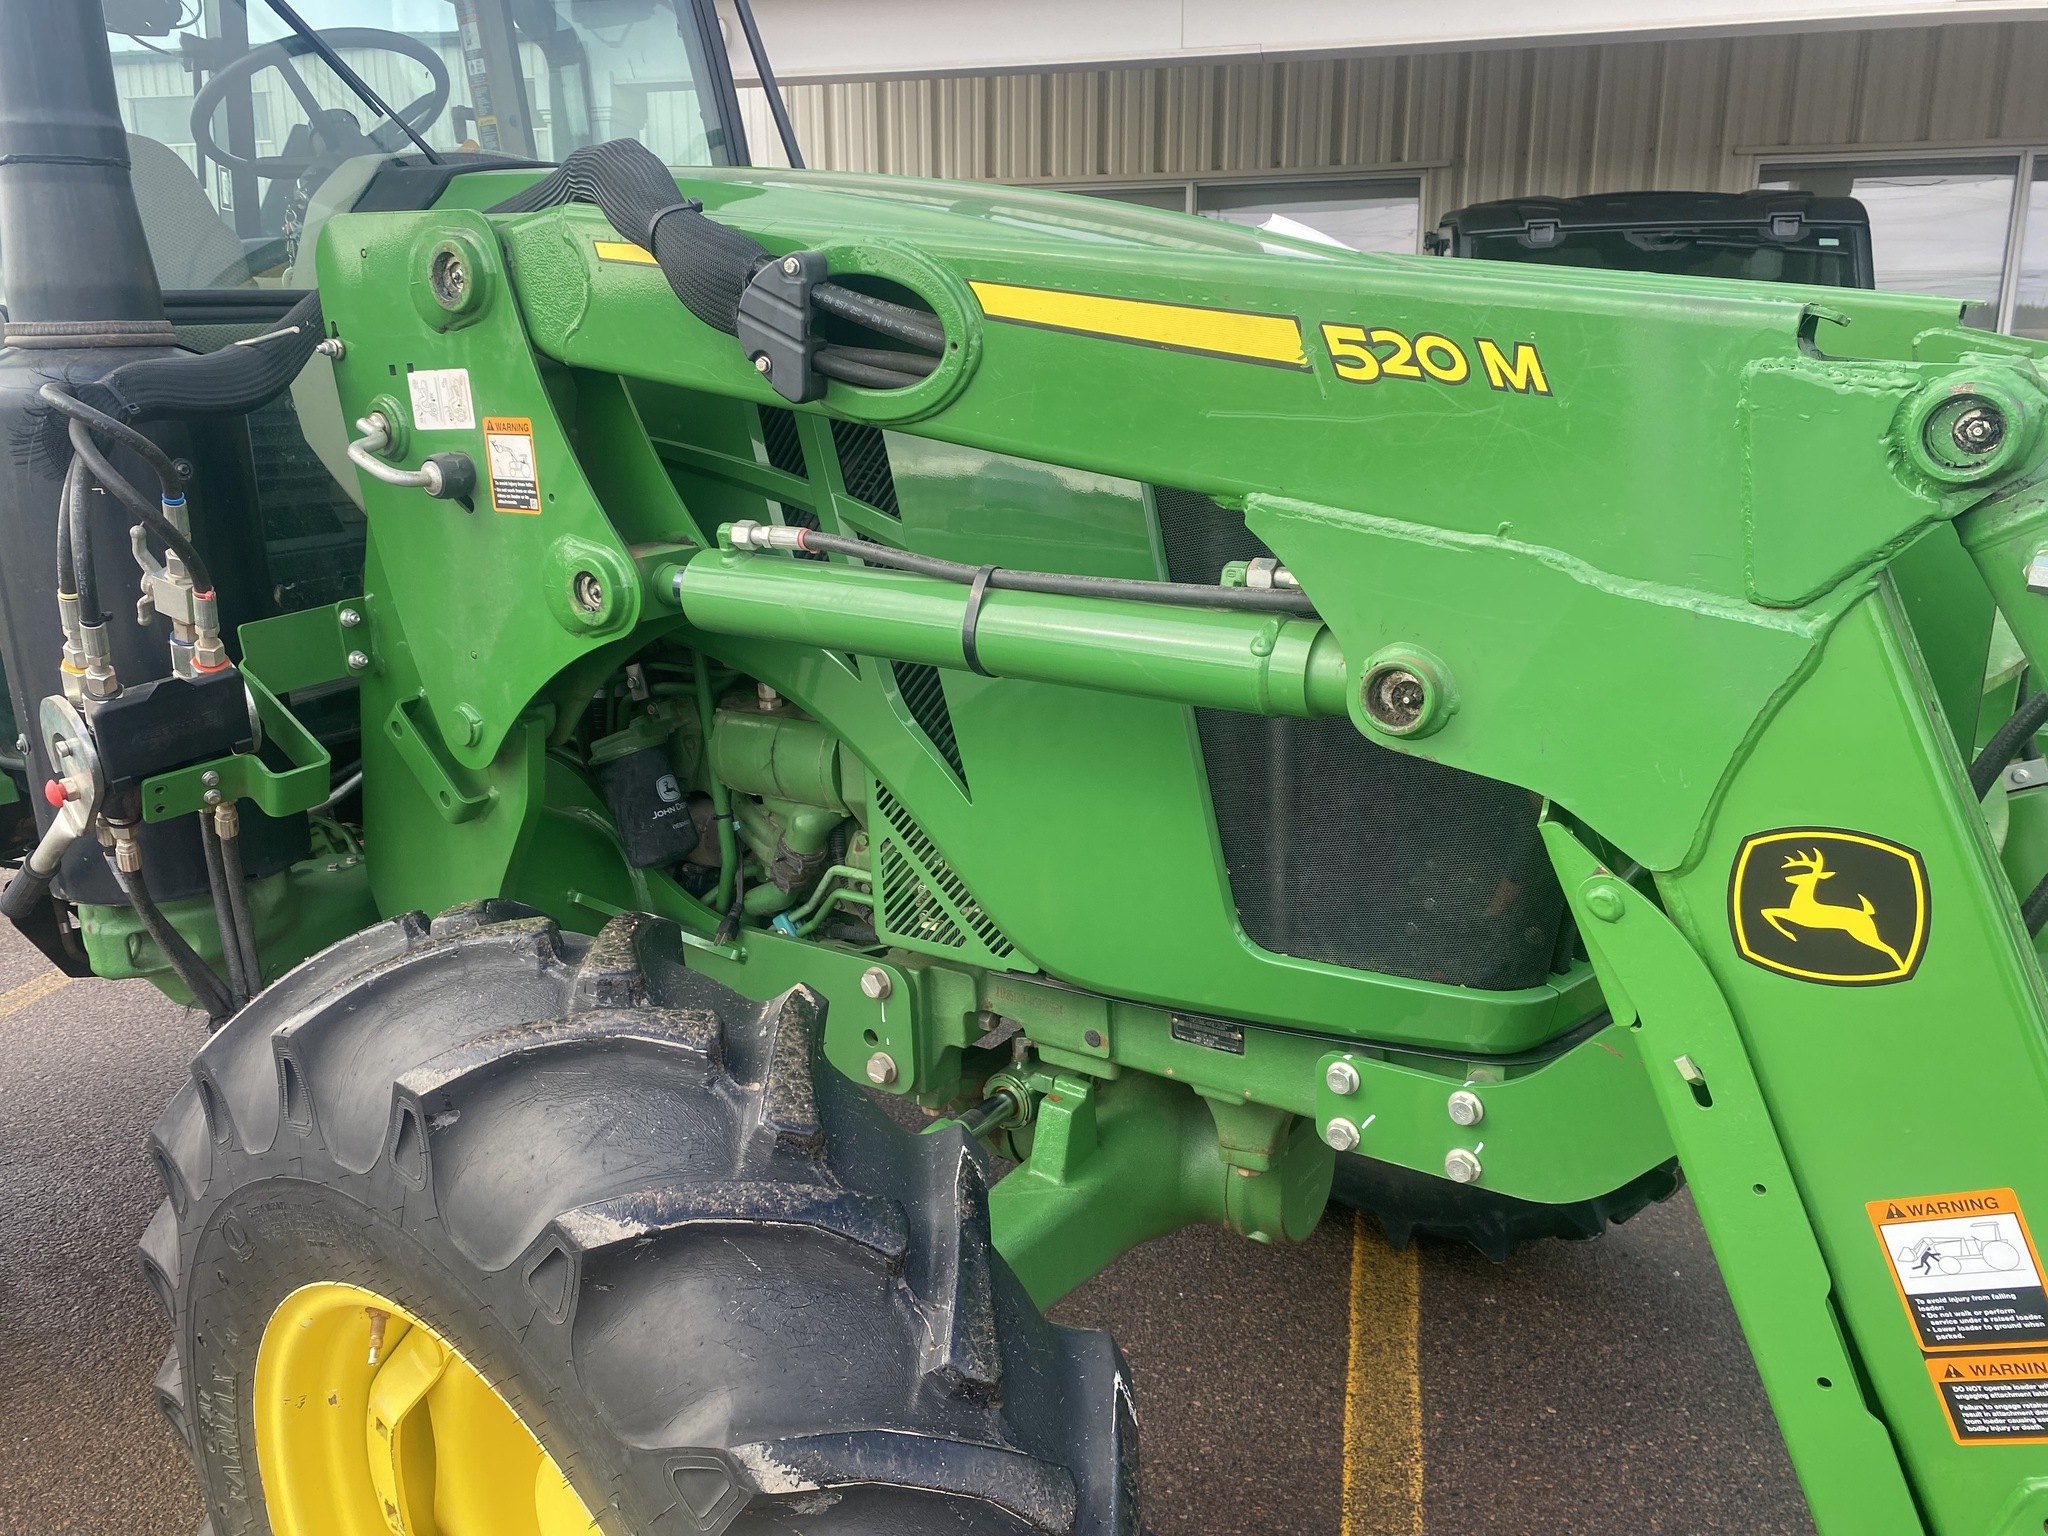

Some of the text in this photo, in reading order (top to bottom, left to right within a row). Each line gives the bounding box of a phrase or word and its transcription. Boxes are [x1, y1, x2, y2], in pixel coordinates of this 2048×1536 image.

[824, 294, 833, 304] EN
[834, 300, 848, 310] 857
[884, 319, 892, 328] 10
[1319, 321, 1553, 397] 520 M
[495, 422, 529, 432] WARNING
[652, 806, 676, 820] JOHN
[1906, 1196, 1999, 1216] WARNING
[1948, 1296, 1970, 1304] injury
[1984, 1308, 2016, 1316] perform
[1994, 1322, 2022, 1331] ground
[1935, 1333, 1965, 1341] parked.
[1983, 1384, 2012, 1392] operate
